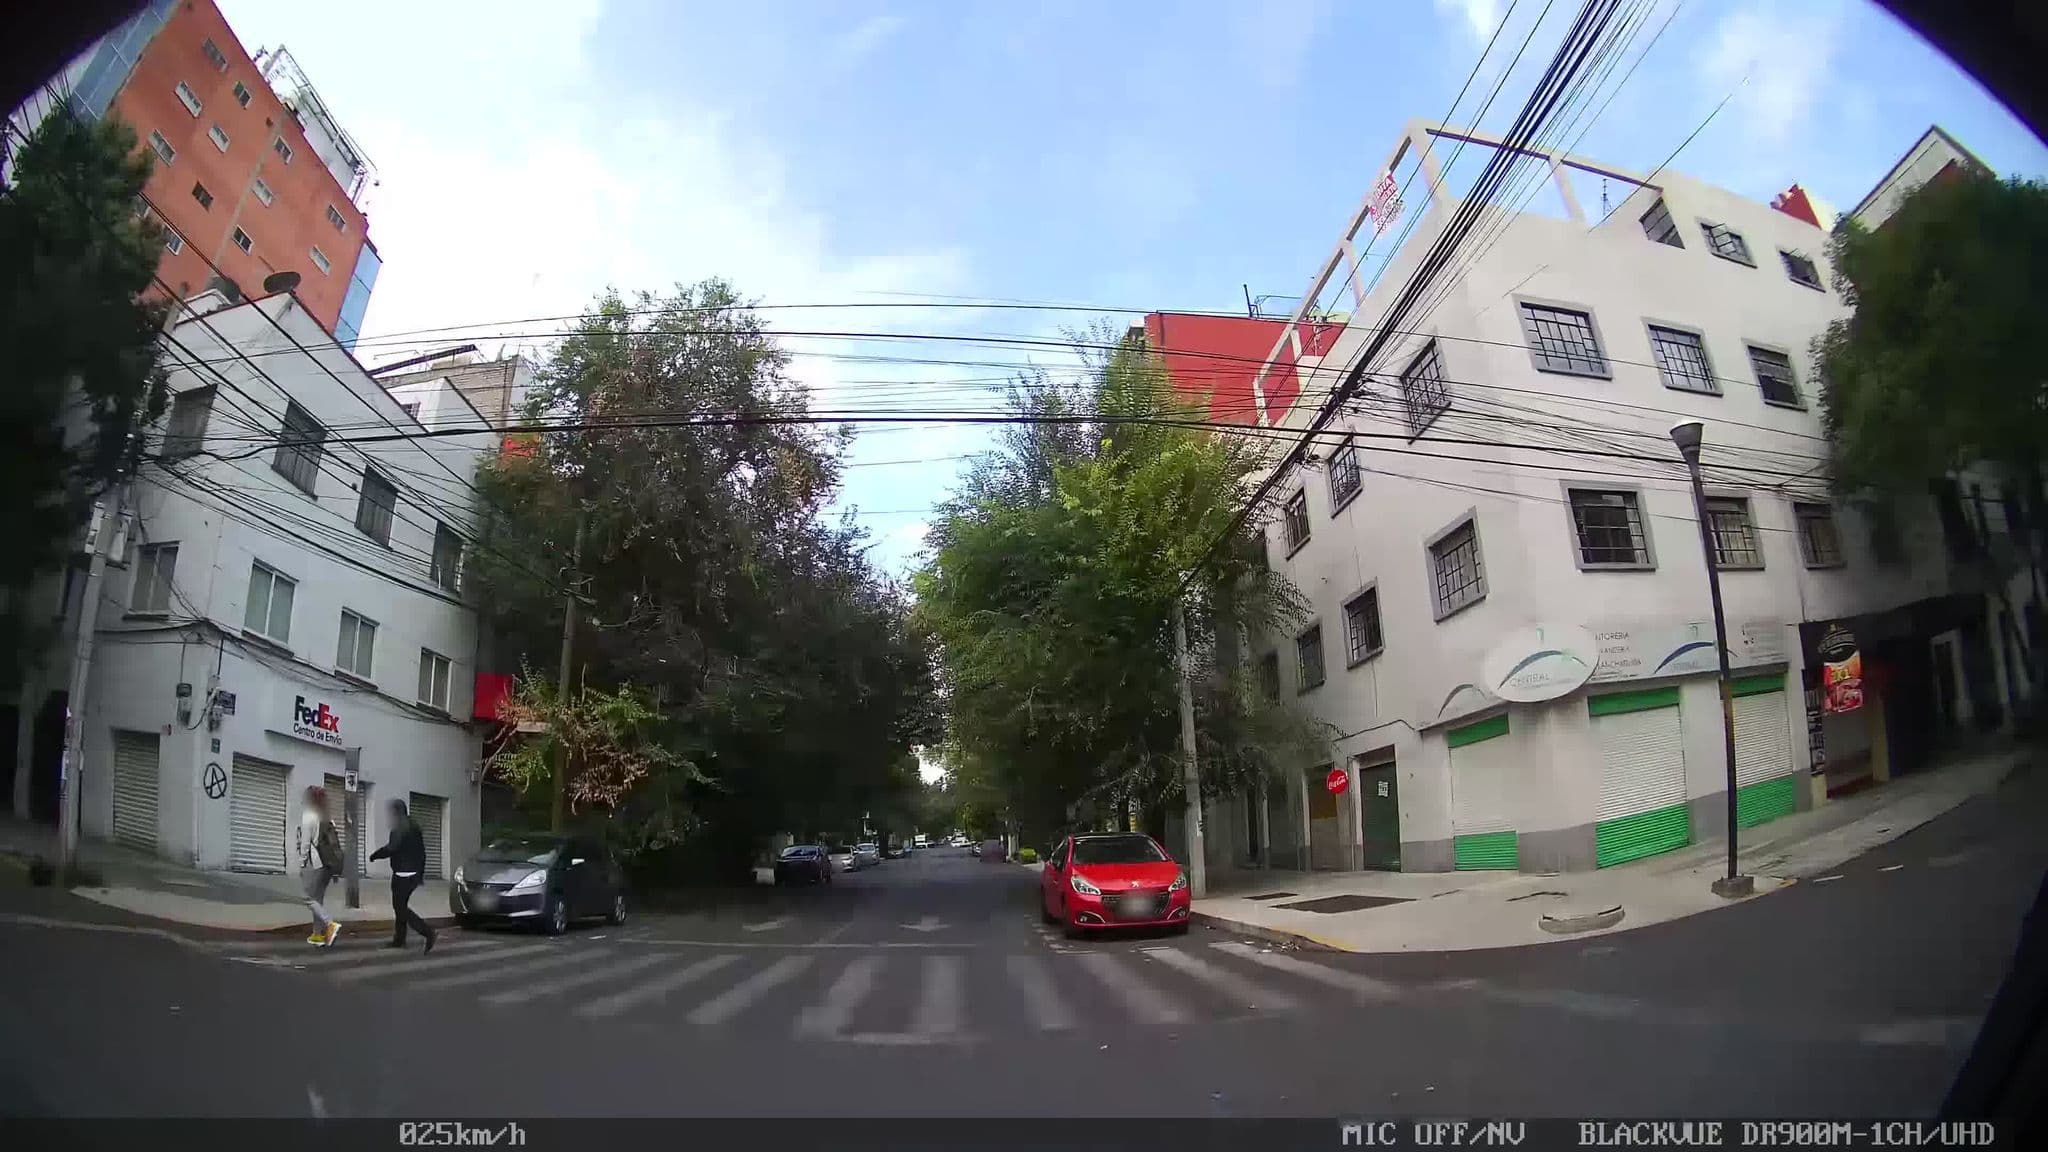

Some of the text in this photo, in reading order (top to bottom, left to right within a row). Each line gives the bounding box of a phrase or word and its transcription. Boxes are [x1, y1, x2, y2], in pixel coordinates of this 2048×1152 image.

[294, 695, 339, 733] FedEx
[293, 722, 315, 738] Centro
[316, 730, 325, 741] de
